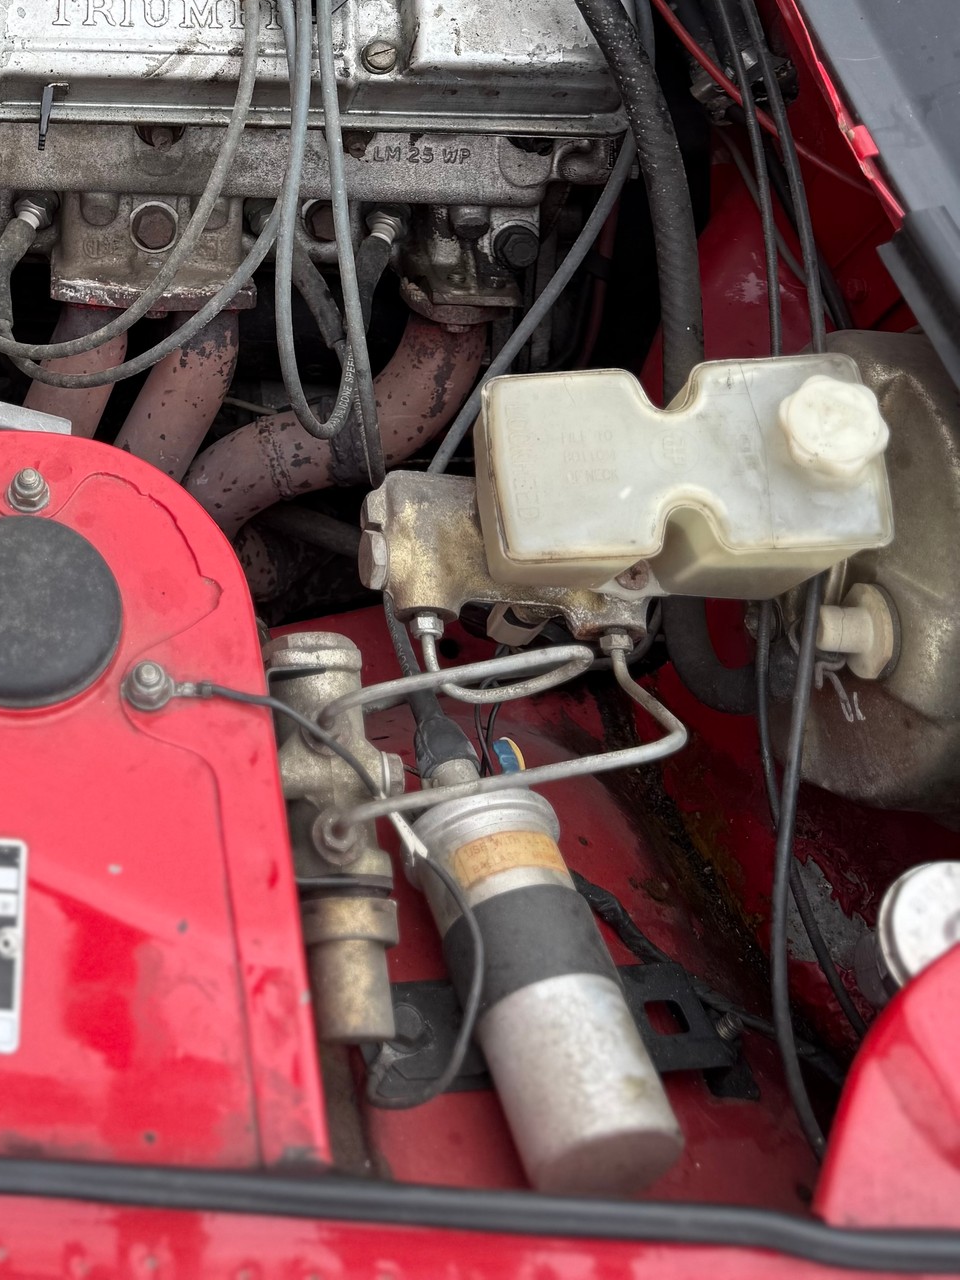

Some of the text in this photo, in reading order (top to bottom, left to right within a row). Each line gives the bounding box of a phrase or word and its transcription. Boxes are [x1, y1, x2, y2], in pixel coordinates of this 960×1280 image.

[373, 145, 472, 164] LM 25 WP
